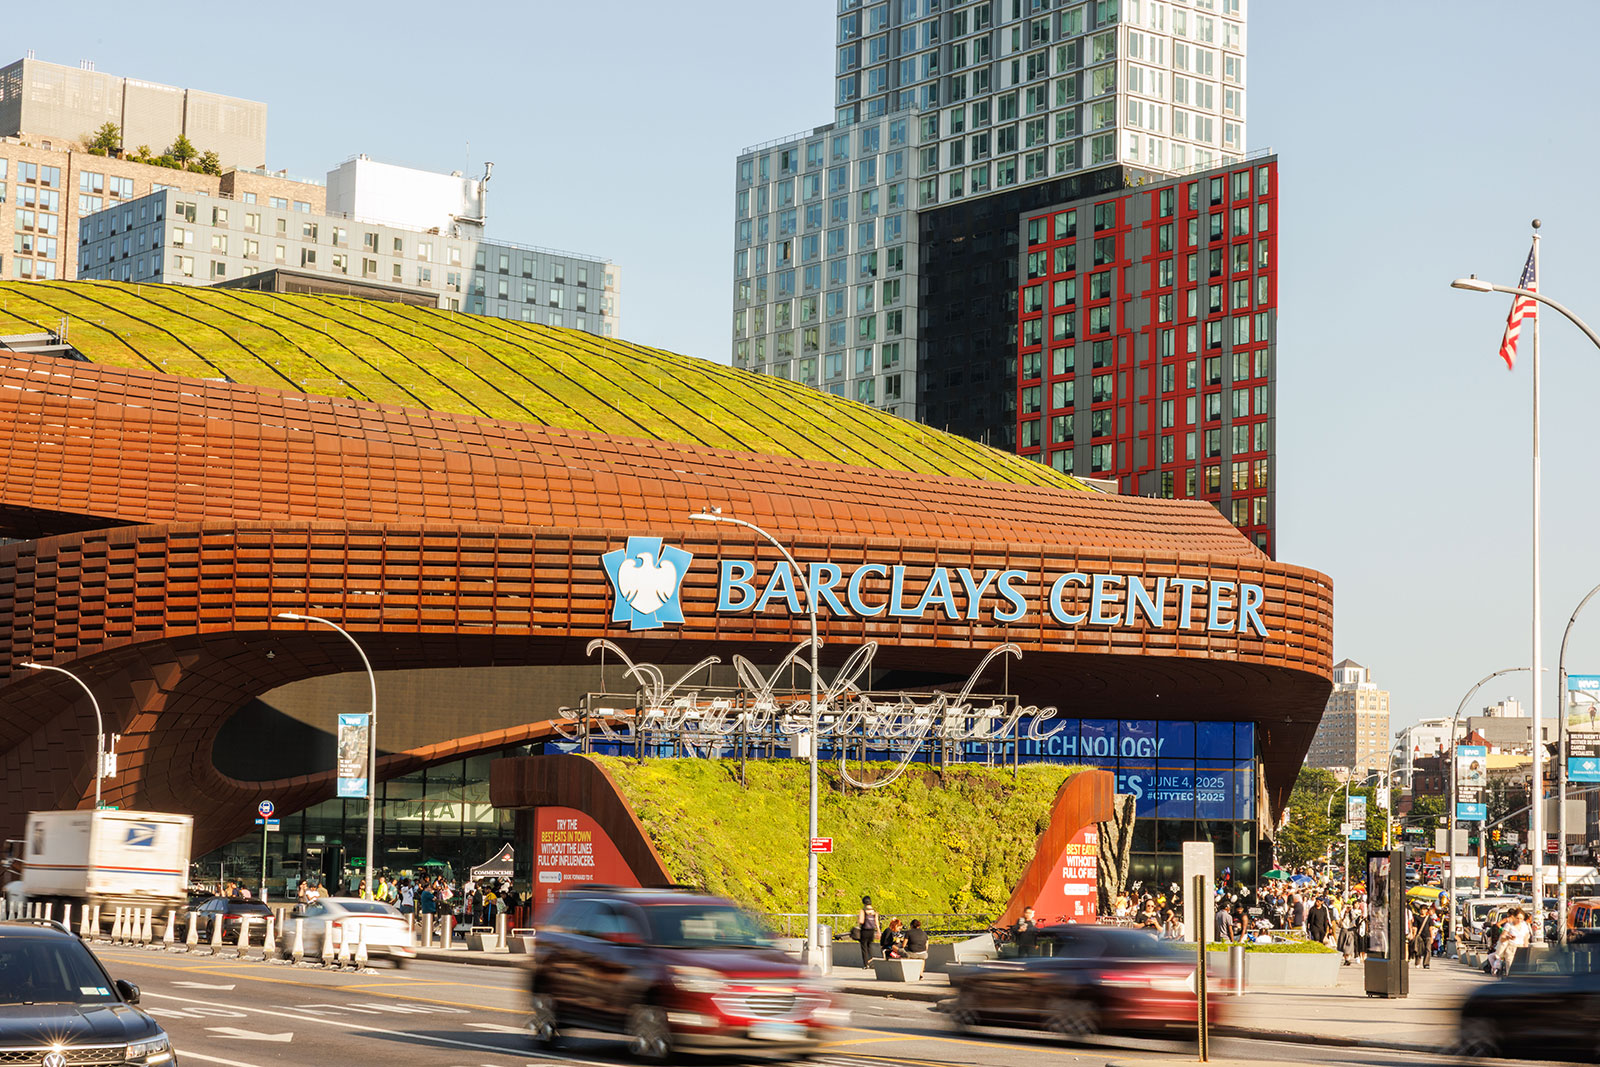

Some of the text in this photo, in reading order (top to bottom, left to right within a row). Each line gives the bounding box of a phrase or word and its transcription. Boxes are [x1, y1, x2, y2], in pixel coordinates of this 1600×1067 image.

[716, 559, 1270, 637] BARCLAYS CENTER
[1022, 735, 1164, 758] TECHNOLOGY
[1148, 776, 1225, 788] JUNE 4, 2025
[1147, 792, 1225, 801] #CITYTECH2025
[557, 819, 578, 830] TRY THE
[541, 831, 592, 842] BEST EATS IN TOWN
[541, 843, 593, 854] WITHOUT THE LINES
[1066, 844, 1081, 855] BEST
[538, 855, 550, 866] FULL
[551, 855, 559, 866] OF
